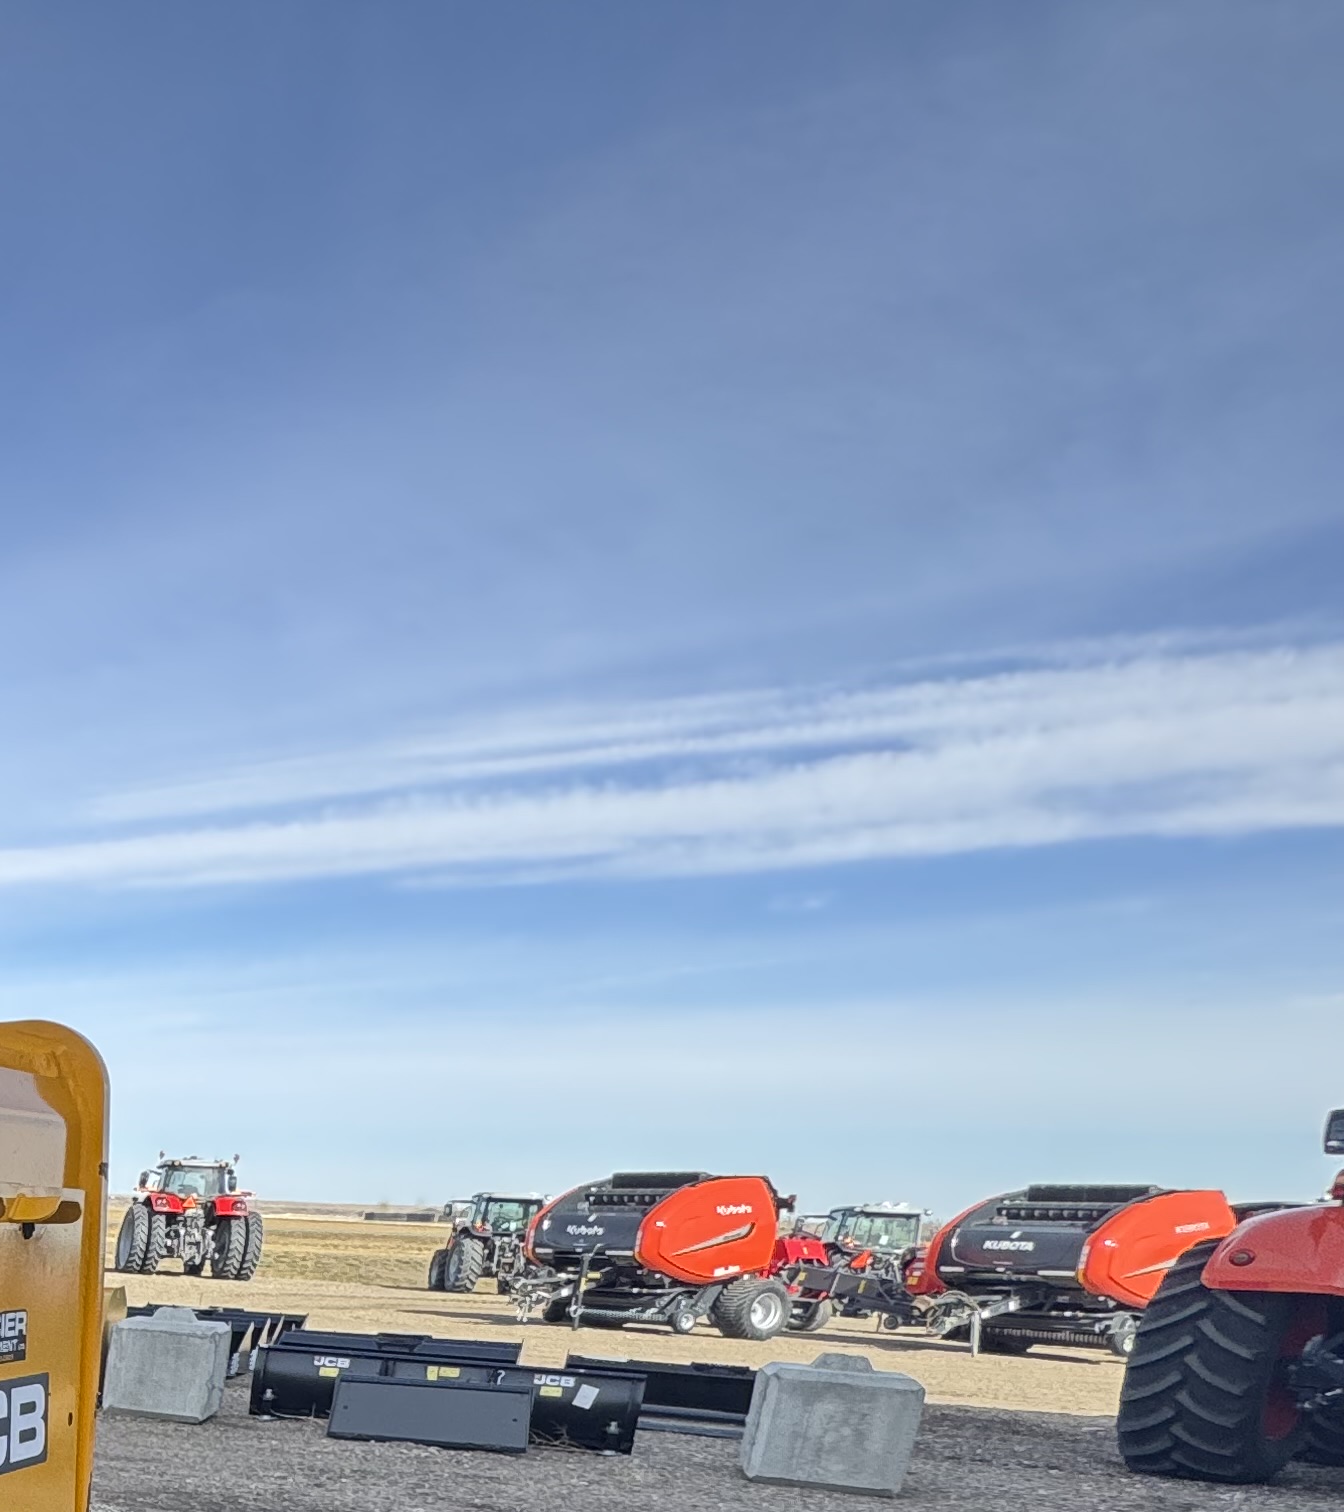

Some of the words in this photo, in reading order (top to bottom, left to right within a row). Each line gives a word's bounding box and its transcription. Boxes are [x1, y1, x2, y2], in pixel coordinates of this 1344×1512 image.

[566, 1224, 604, 1236] Kubota
[982, 1240, 1035, 1251] KUBOTA
[313, 1355, 351, 1369] JCB
[533, 1374, 576, 1388] JCB
